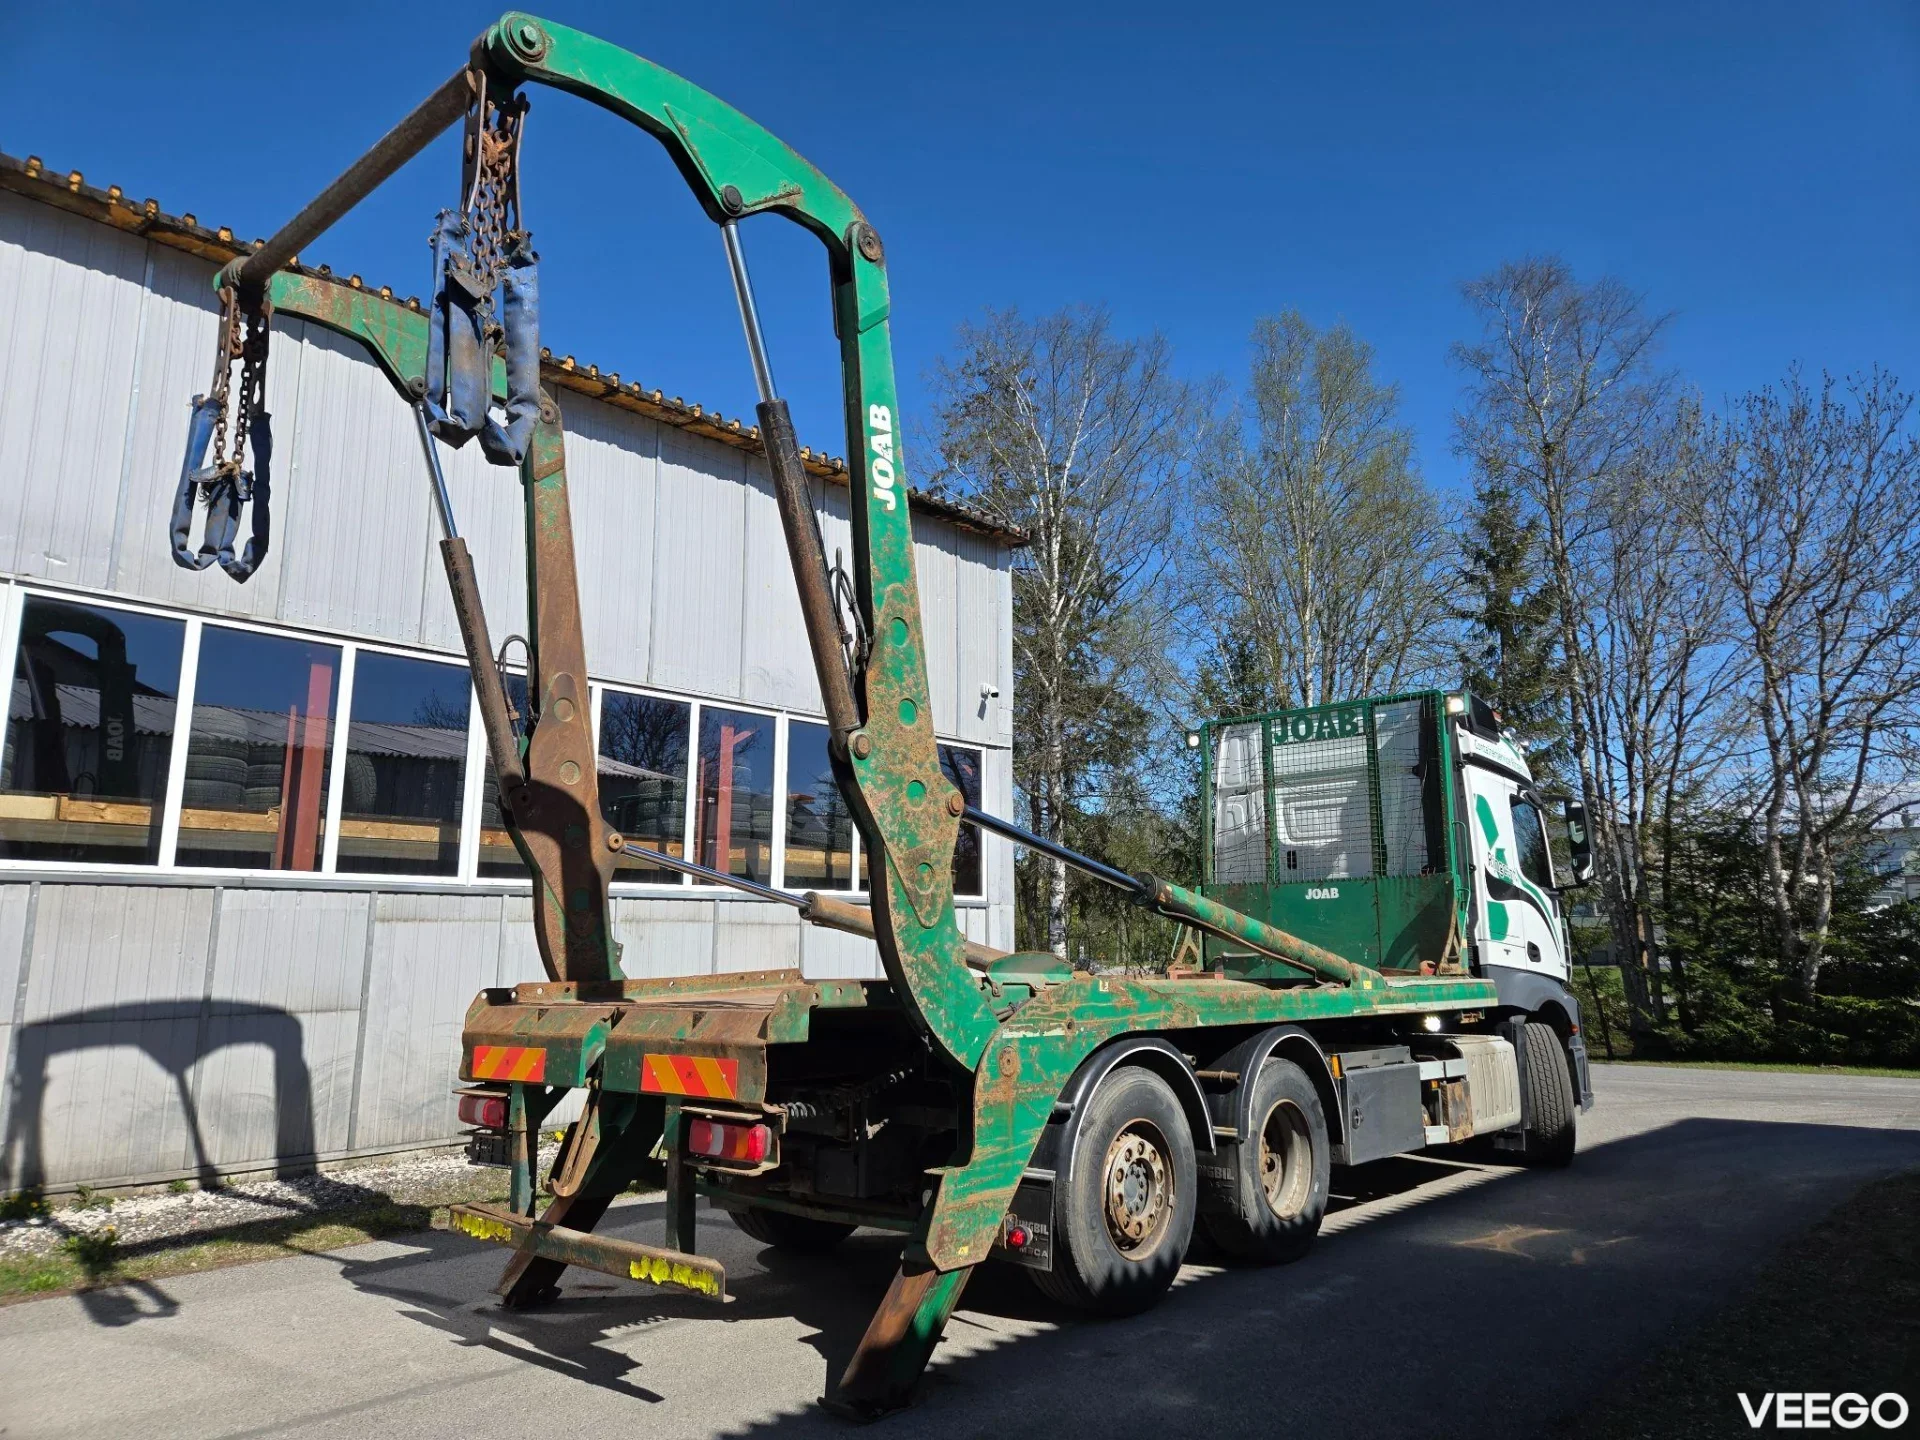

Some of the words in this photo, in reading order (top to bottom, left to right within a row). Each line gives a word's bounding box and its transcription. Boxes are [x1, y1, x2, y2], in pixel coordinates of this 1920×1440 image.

[870, 404, 896, 511] JOAB
[1272, 708, 1359, 744] JOAB
[1305, 887, 1340, 900] JOAB
